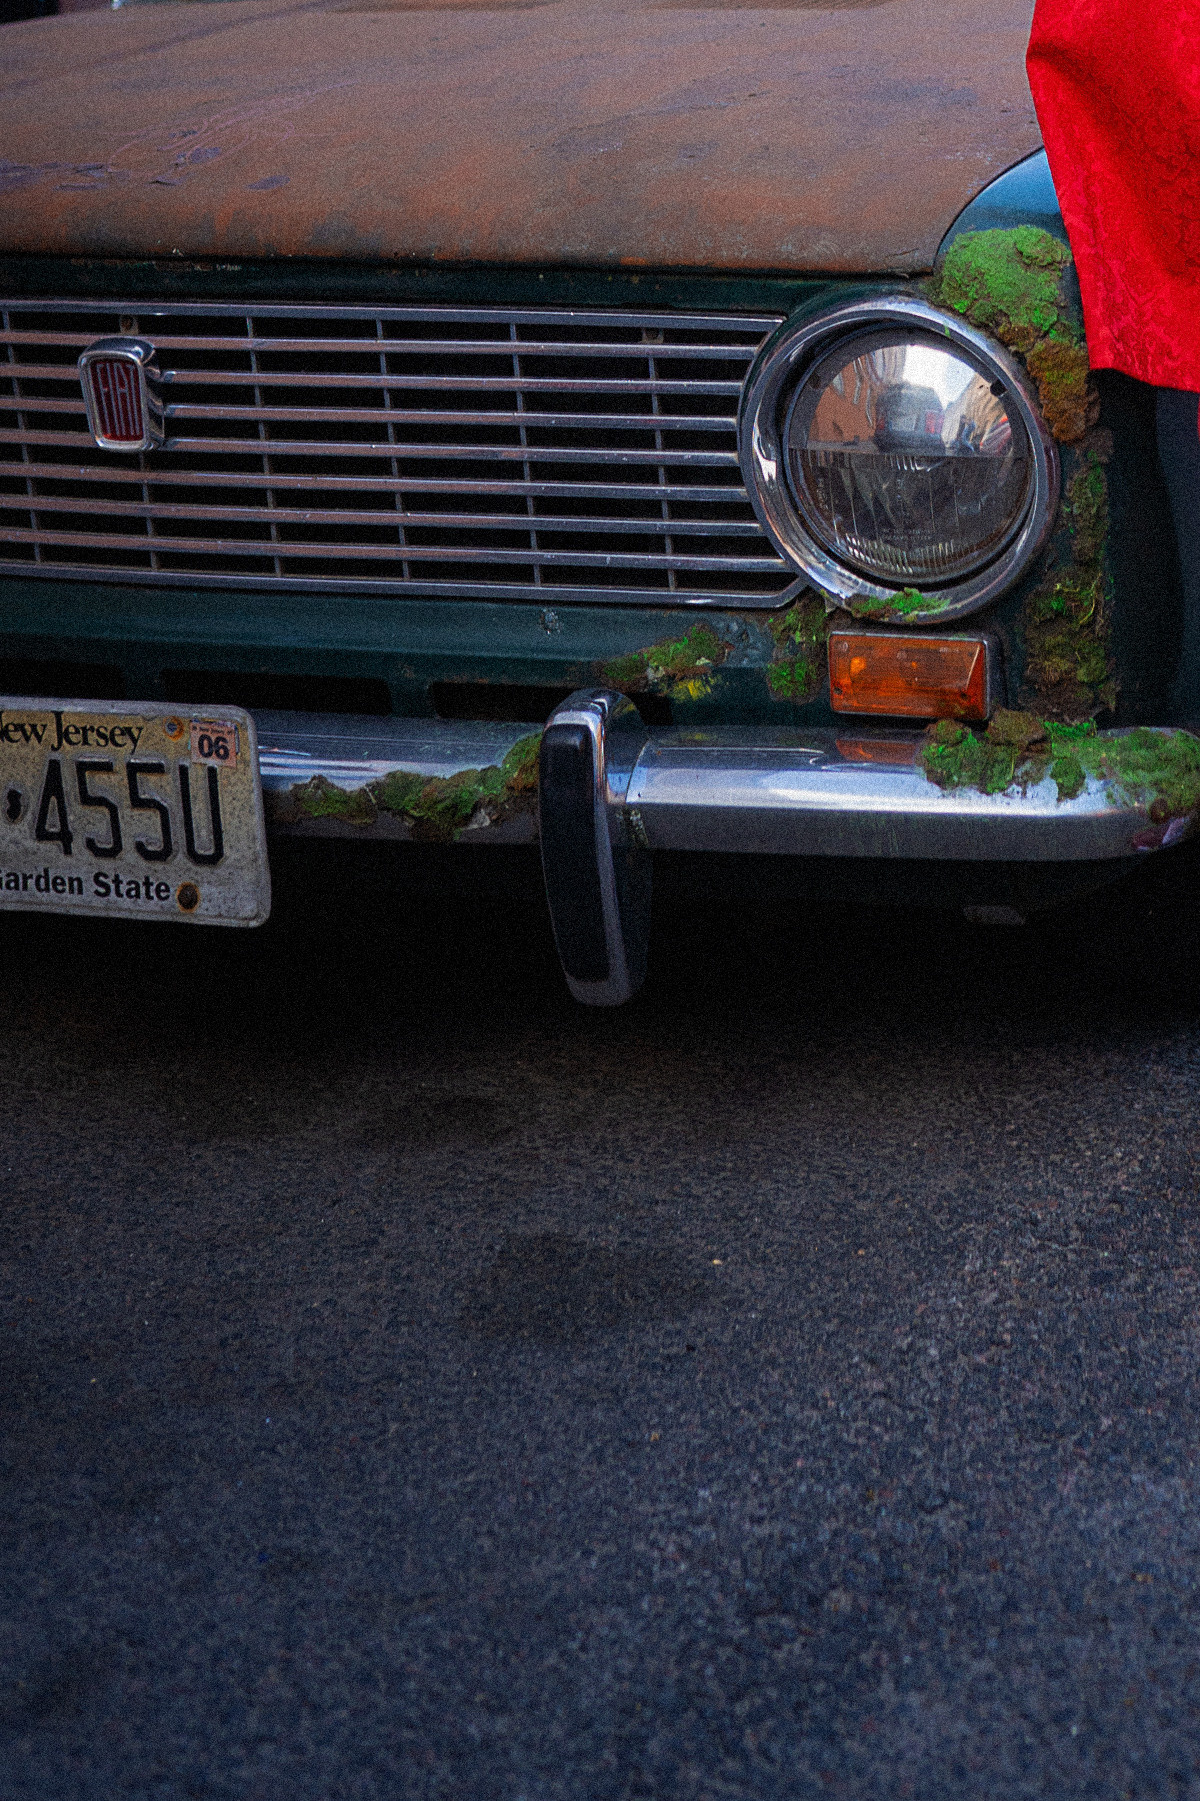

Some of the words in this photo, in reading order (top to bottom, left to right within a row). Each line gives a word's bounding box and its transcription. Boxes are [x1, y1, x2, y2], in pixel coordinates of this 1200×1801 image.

[95, 362, 141, 437] FIAT
[0, 710, 47, 744] ew
[51, 710, 143, 755] Jersey
[198, 733, 230, 760] 06
[35, 757, 225, 866] 455U
[0, 867, 84, 895] arden
[93, 871, 171, 901] State
